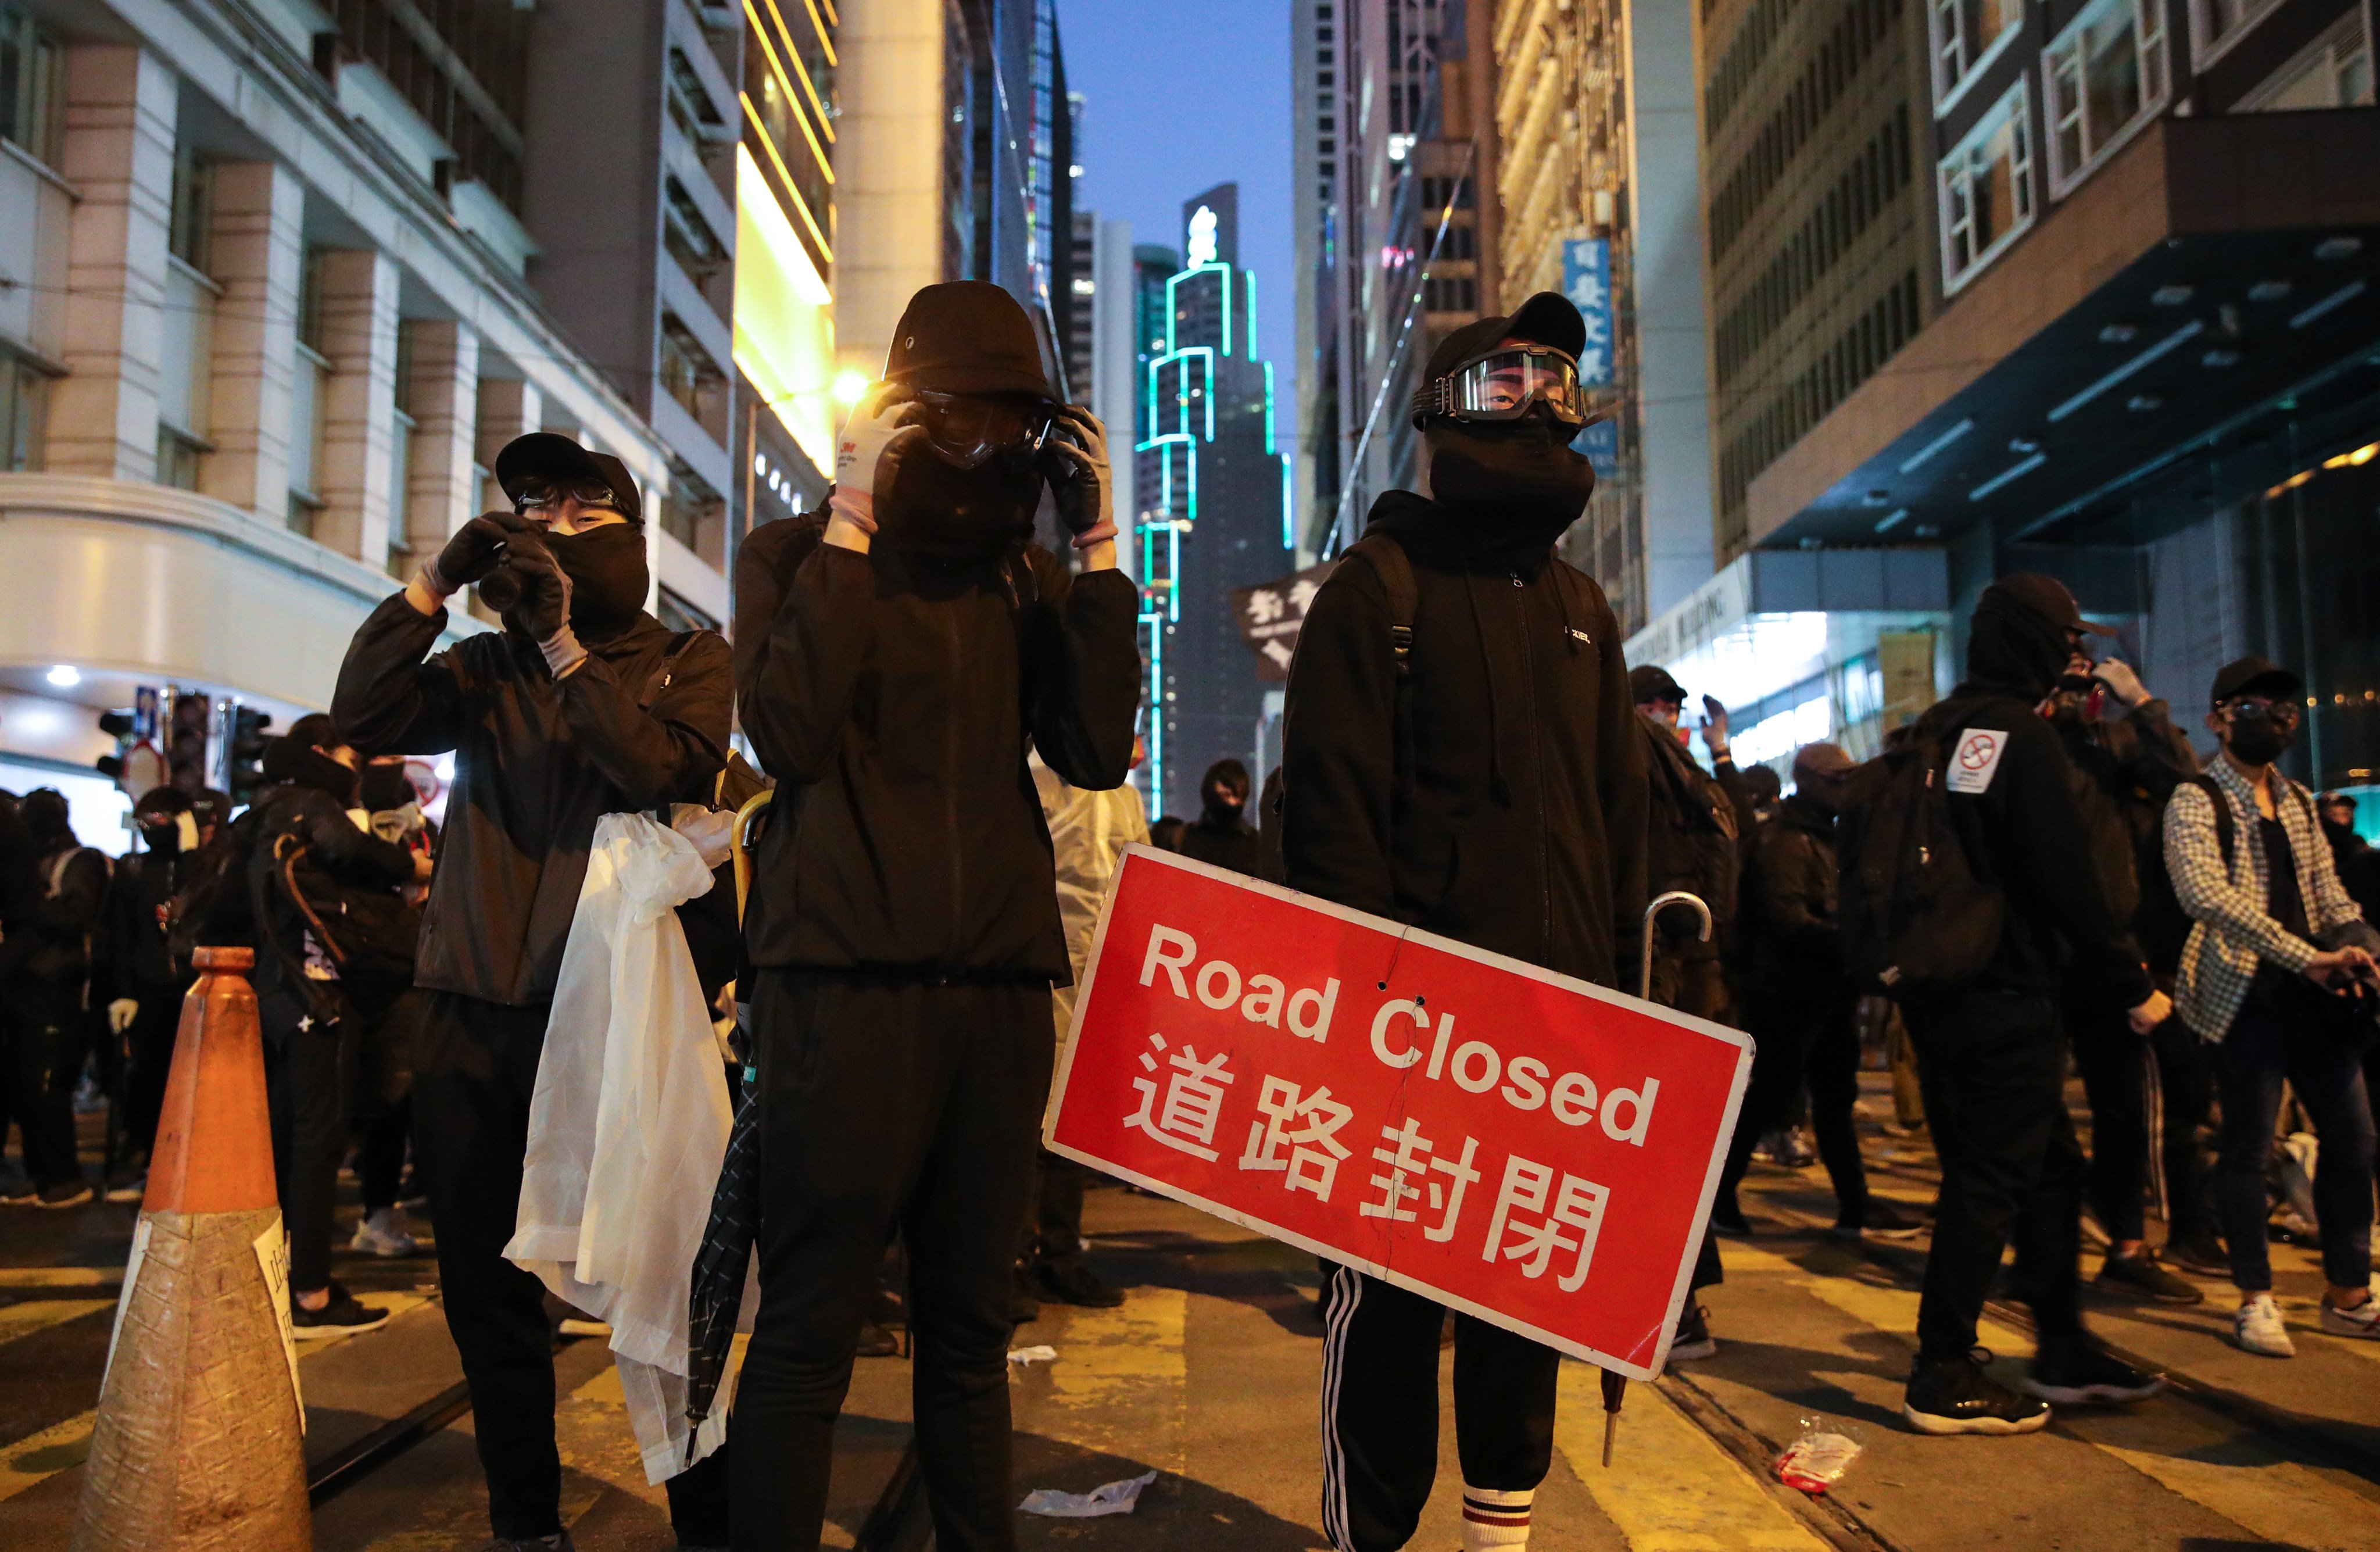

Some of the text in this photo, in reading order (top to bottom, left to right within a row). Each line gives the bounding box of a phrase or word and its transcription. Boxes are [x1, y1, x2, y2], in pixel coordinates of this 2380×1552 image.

[1139, 923, 1660, 1147] Road Closed
[1122, 1032, 1610, 1292] 道路封閉
